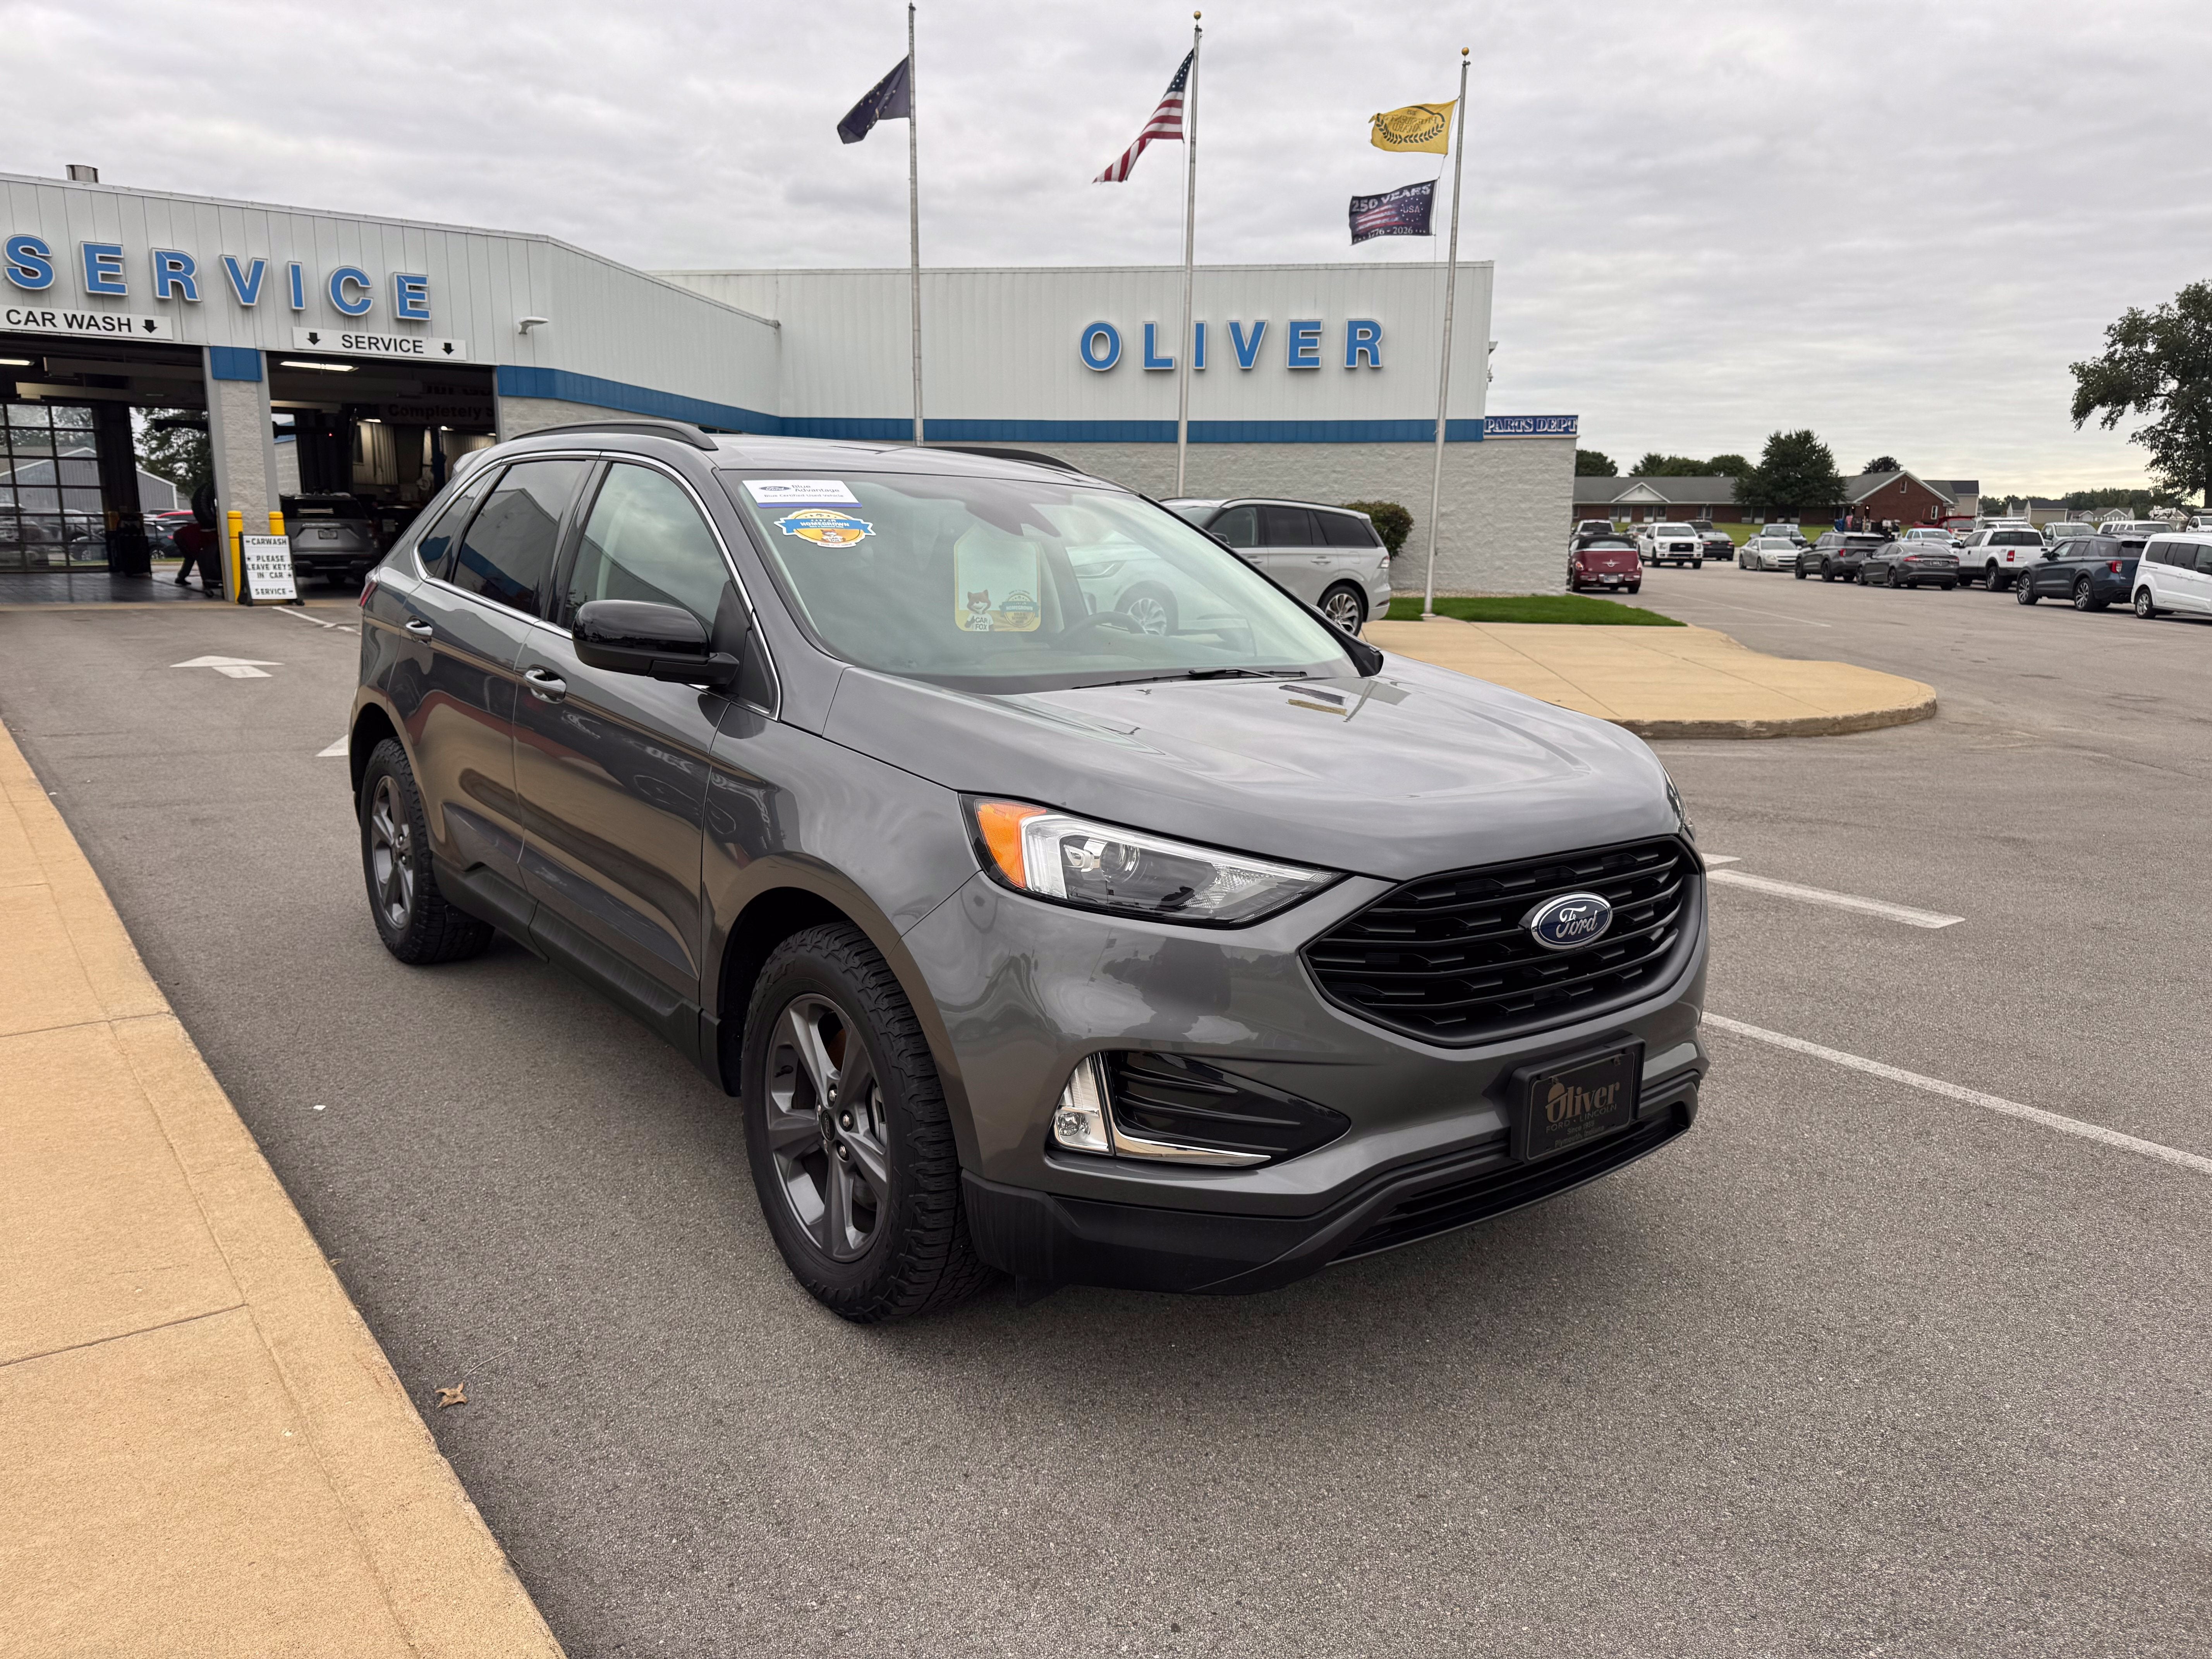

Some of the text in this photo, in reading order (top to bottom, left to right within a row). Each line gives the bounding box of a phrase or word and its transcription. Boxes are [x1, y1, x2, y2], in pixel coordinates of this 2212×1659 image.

[1352, 184, 1431, 212] 250 YEARS
[1368, 228, 1384, 238] 1776
[3, 235, 431, 321] SERVICE
[6, 309, 132, 333] CAR WASH
[342, 334, 424, 354] SERVICE
[1079, 319, 1383, 371] OLIVER
[388, 404, 481, 420] Completely
[1484, 418, 1577, 433] PARTS DEPT
[1556, 905, 1598, 938] Ford
[1545, 1082, 1620, 1123] Oliver
[1546, 1104, 1617, 1133] FORD LINCOLN
